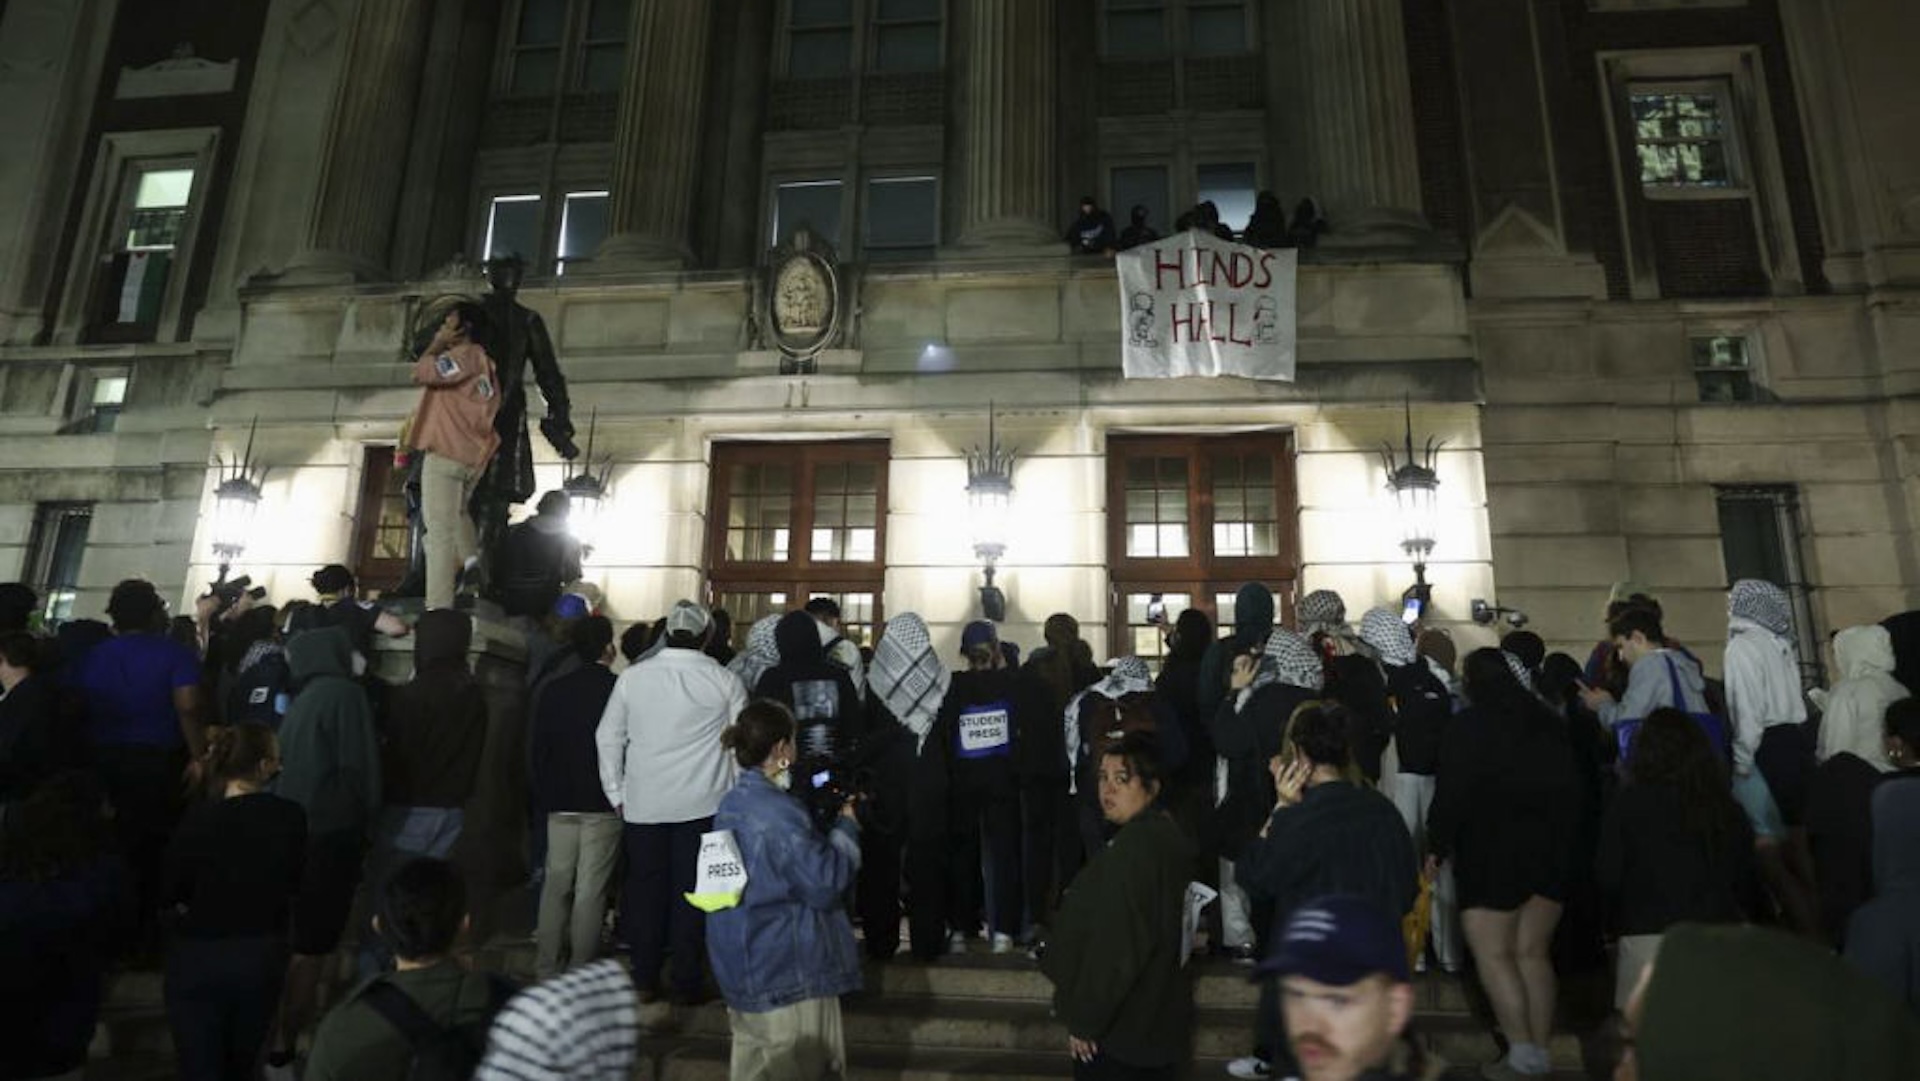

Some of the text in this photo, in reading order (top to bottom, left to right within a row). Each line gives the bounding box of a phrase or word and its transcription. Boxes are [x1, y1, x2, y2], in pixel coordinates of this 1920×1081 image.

[1155, 248, 1276, 289] HINDS
[960, 714, 1006, 726] STUDENT
[969, 728, 1001, 738] PRESS
[708, 863, 741, 879] PRESS
